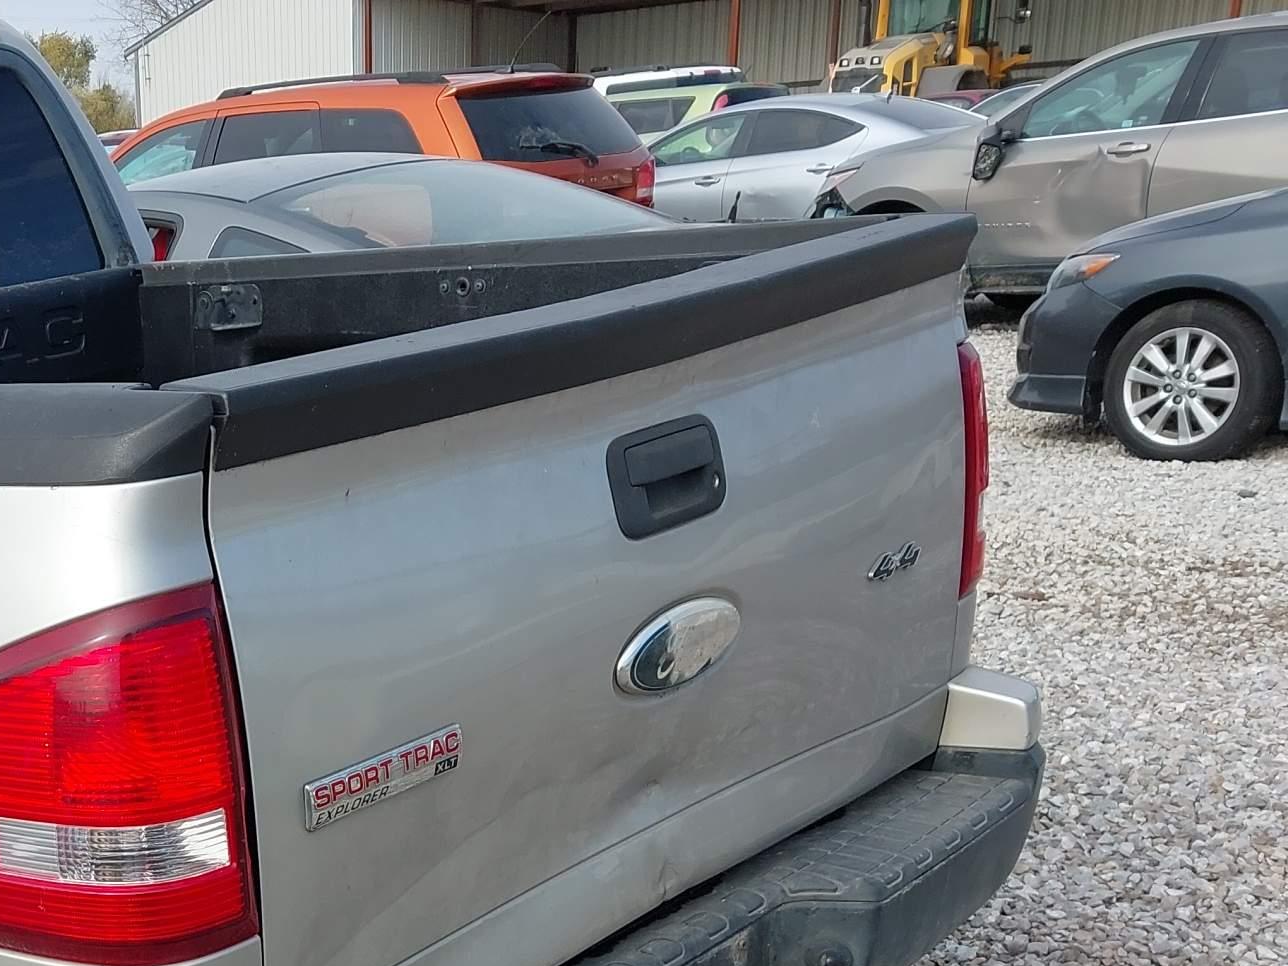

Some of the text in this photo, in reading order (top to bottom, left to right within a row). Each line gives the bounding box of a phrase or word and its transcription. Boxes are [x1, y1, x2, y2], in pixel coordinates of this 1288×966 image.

[314, 731, 461, 809] SPORT TRAC
[436, 756, 458, 773] XLT
[315, 785, 390, 826] EXPLORER
